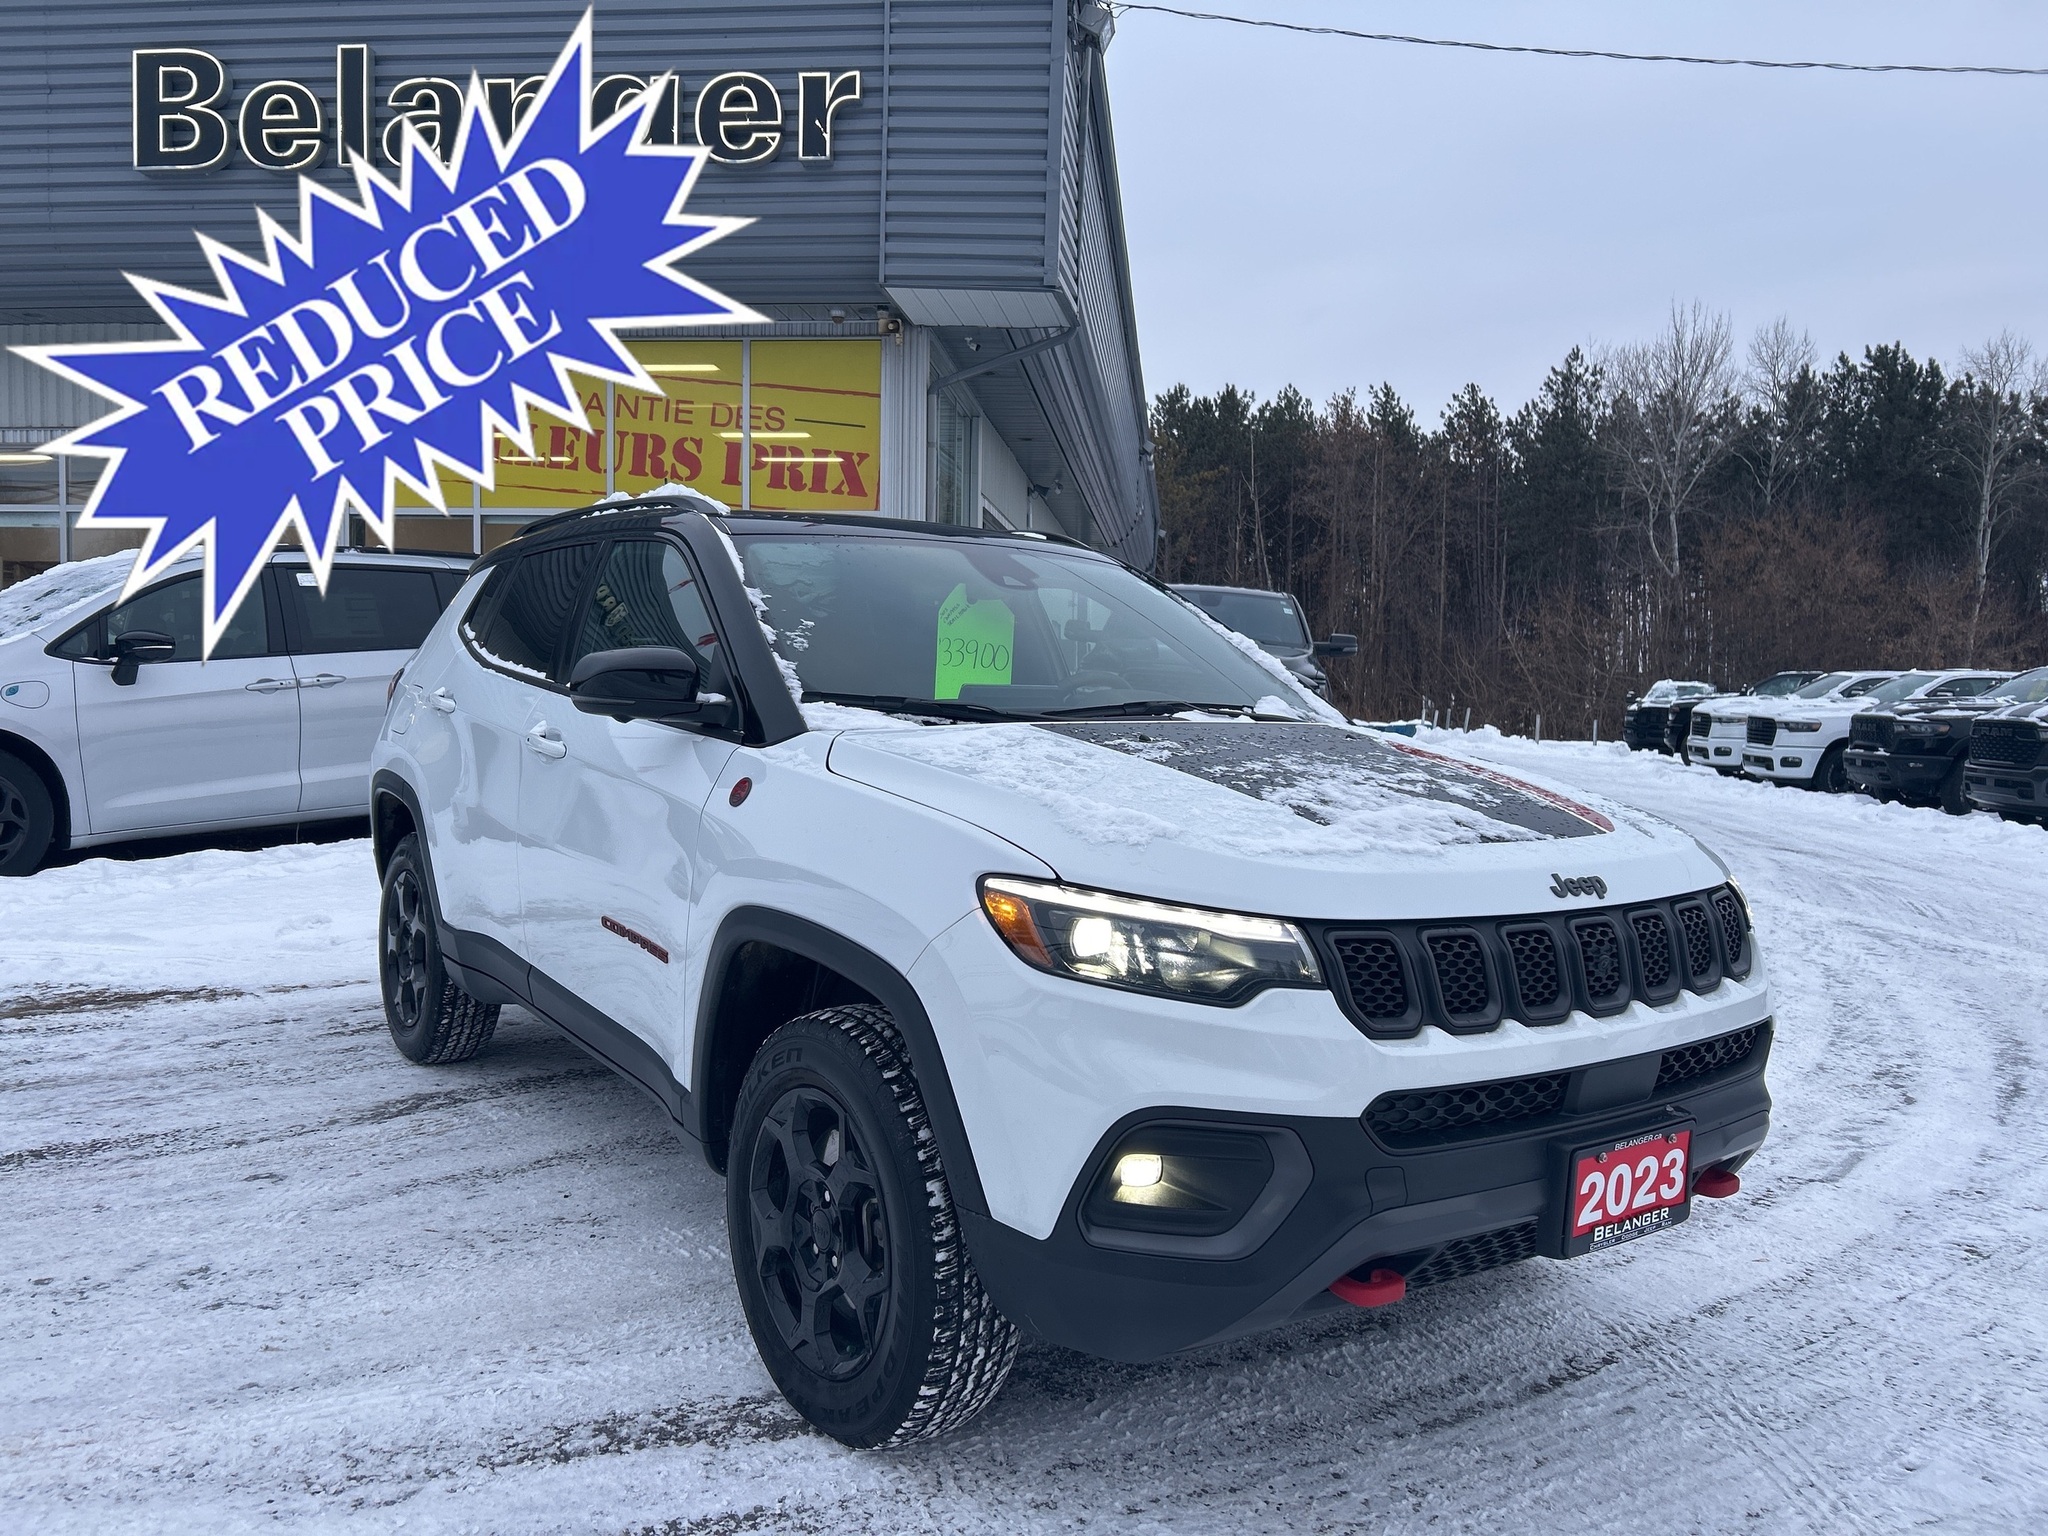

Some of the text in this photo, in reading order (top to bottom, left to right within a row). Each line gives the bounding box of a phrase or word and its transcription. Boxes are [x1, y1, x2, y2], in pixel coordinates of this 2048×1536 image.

[710, 403, 786, 431] DES
[721, 441, 870, 497] PRIX
[1550, 873, 1607, 899] Jeep
[1577, 1148, 1685, 1227] 2023
[1593, 1207, 1669, 1242] BELANGER
